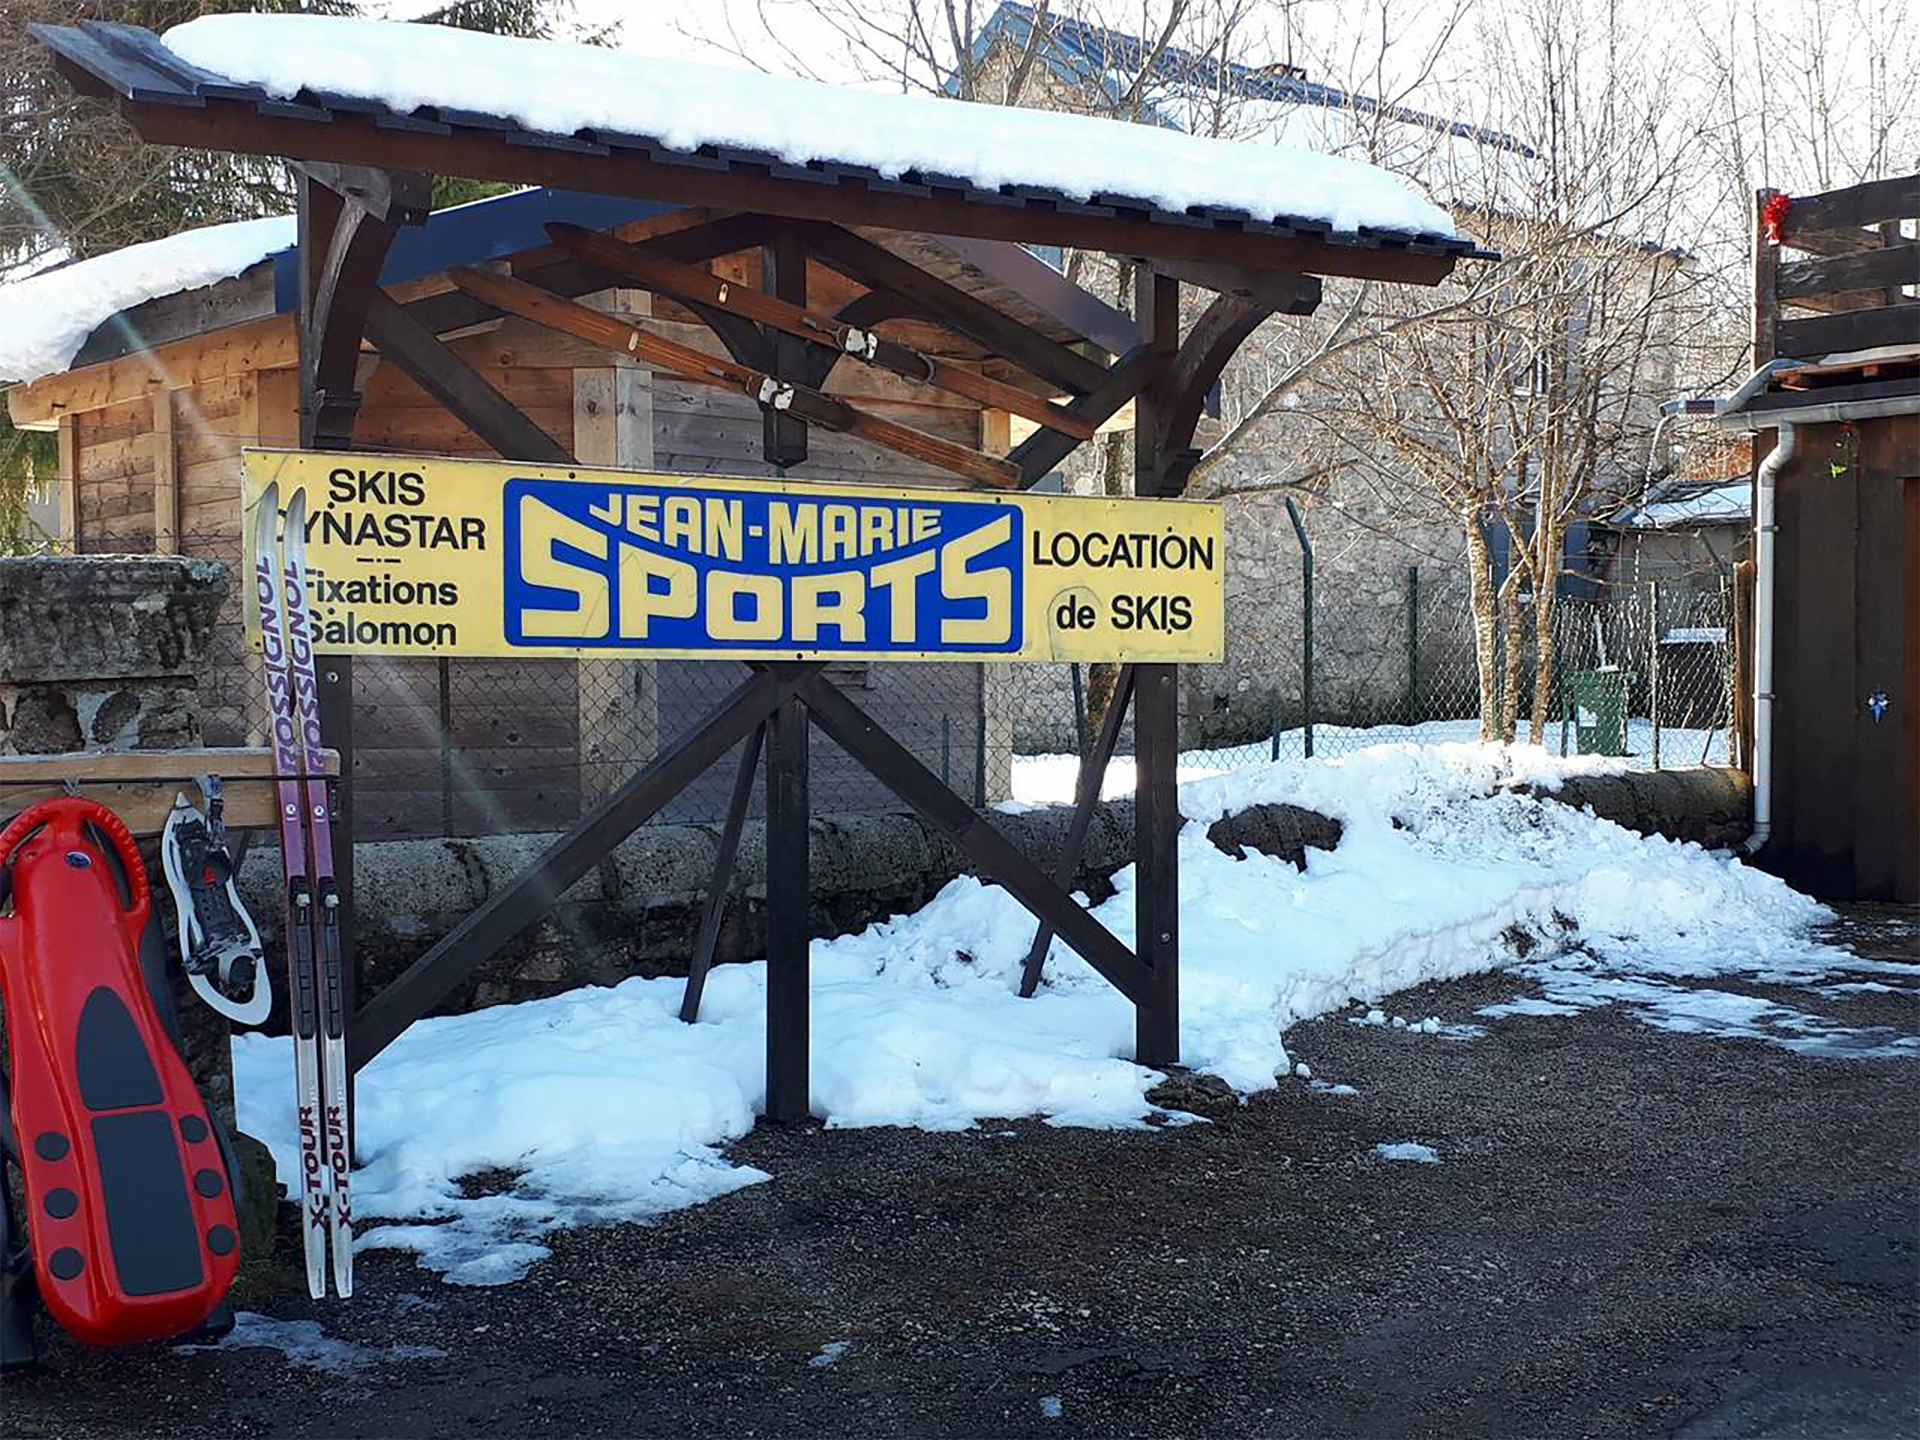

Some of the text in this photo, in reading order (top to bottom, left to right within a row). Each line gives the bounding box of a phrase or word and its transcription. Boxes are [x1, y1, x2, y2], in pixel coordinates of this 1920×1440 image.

[328, 468, 426, 507] SKIS
[277, 509, 486, 551] YNASTAR
[588, 492, 942, 565] JEAN-MARIE
[1032, 530, 1214, 570] LOCATION
[520, 494, 1012, 644] SPORTS
[309, 608, 457, 646] Salomon
[1055, 594, 1193, 632] de SKIS
[256, 556, 298, 773] ROSSIGNOL
[284, 561, 325, 774] ROSSIGNOL
[299, 1105, 325, 1230] X-TOUR
[327, 1105, 352, 1230] X-TOUR
